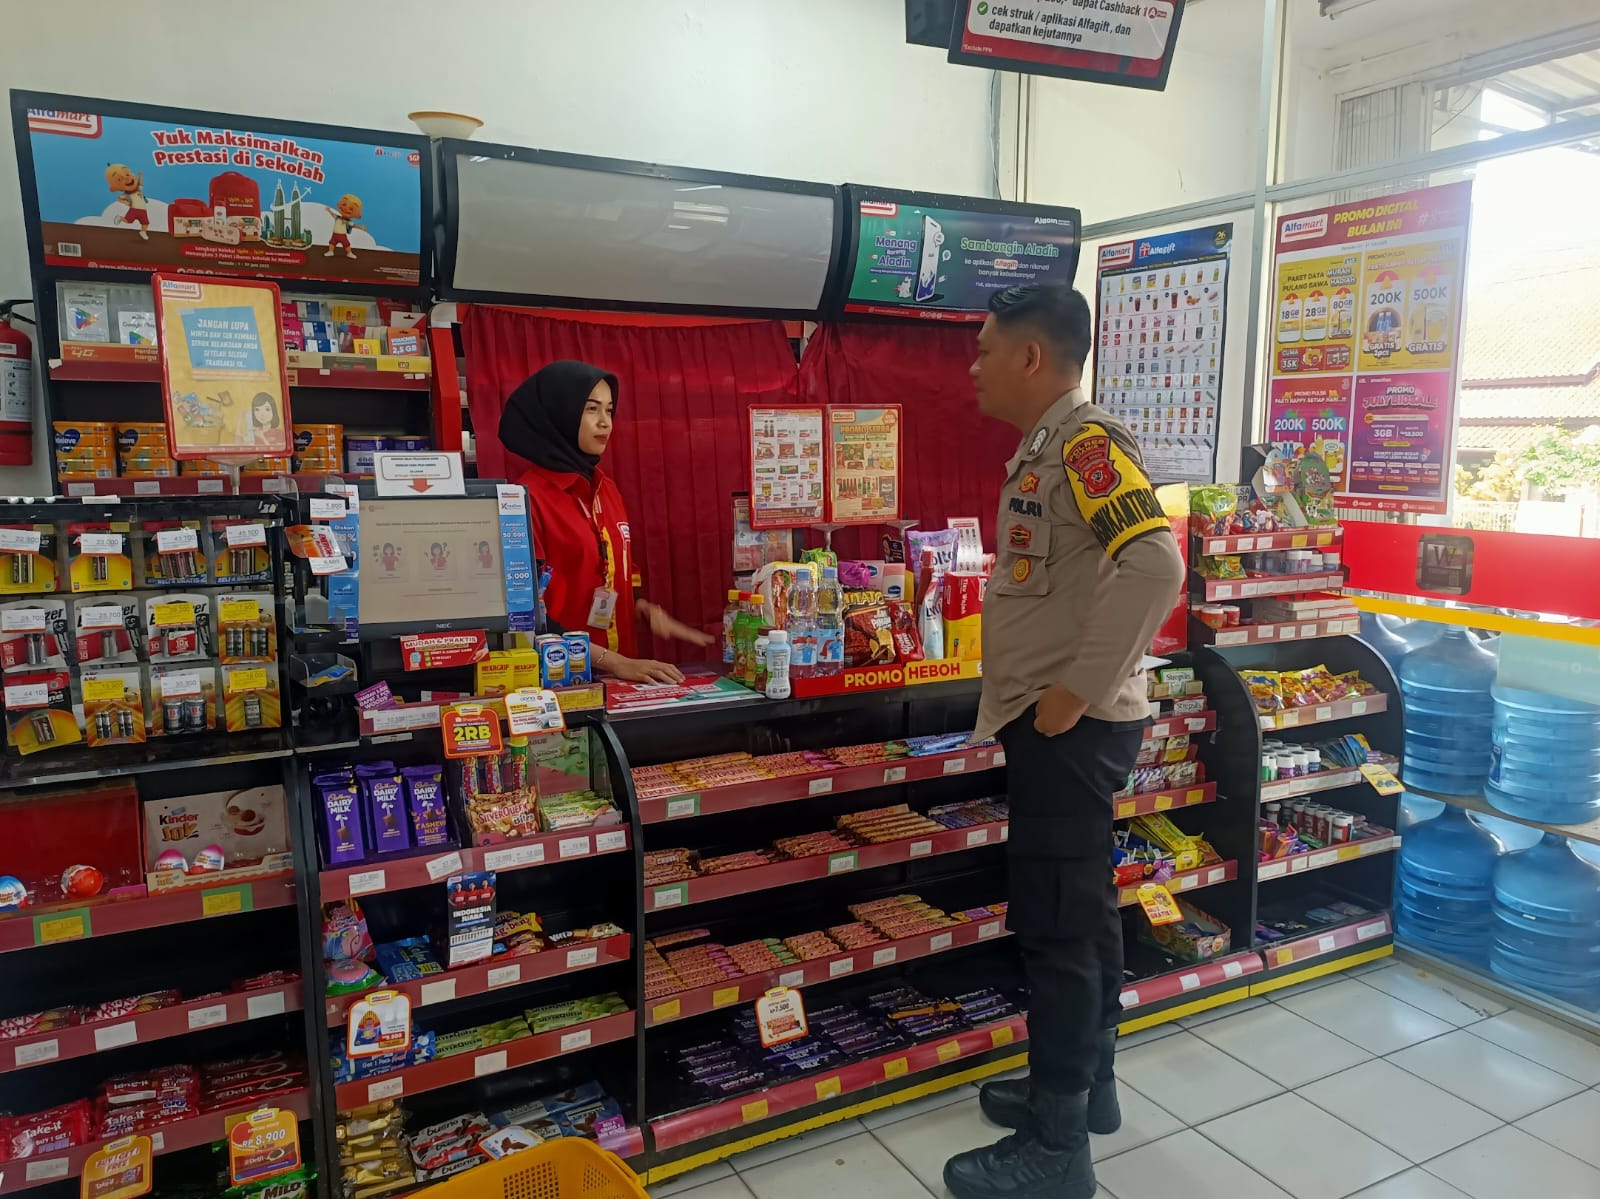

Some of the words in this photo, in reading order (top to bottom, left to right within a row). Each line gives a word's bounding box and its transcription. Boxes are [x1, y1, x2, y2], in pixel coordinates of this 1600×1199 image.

[1100, 0, 1141, 17] Cashback
[992, 6, 1008, 17] cek
[1009, 8, 1035, 21] struk
[1041, 13, 1076, 28] aplikasi
[1115, 25, 1132, 36] dan
[989, 18, 1031, 36] dapatkan
[1032, 26, 1082, 43] kejutannya
[153, 129, 191, 146] Yuk
[197, 131, 323, 165] Maksimalkan
[154, 149, 228, 166] Prestasi
[233, 150, 251, 165] di
[255, 155, 325, 183] Sekolah
[1333, 206, 1376, 225] PROMO
[1376, 200, 1419, 218] DIGITAL
[1284, 219, 1323, 233] Alfamart
[1347, 222, 1385, 238] BULAN
[1386, 220, 1404, 234] INI
[875, 236, 917, 250] Menang
[961, 238, 1023, 256] Sambungin
[1024, 241, 1060, 258] Aladin
[1101, 246, 1132, 258] Alfamart
[878, 256, 912, 267] Aladin
[1287, 274, 1307, 283] PAKET
[1308, 271, 1325, 280] DATA
[1326, 267, 1351, 277] MURAH
[162, 282, 196, 291] Alfamart
[1282, 283, 1308, 292] PULANG
[1308, 280, 1329, 289] BAWA
[1370, 290, 1403, 305] 200K
[1413, 286, 1448, 302] 500K
[197, 319, 229, 330] JANGAN
[230, 320, 249, 331] LUPA
[405, 344, 418, 353] GB
[1369, 342, 1394, 351] GRATIS
[1408, 342, 1445, 353] GRATIS
[1282, 360, 1299, 369] 35K
[1386, 386, 1415, 395] PROMO
[1274, 418, 1304, 431] 200K
[1311, 417, 1344, 431] 500K
[1373, 429, 1393, 438] 3GB
[1008, 497, 1042, 518] POLRI
[200, 574, 208, 583] 2
[260, 573, 268, 581] 2
[507, 572, 530, 580] 5.000
[175, 639, 189, 647] 10x
[405, 639, 436, 649] MUDAH
[443, 636, 477, 644] PRAKTIS
[6, 657, 16, 665] 10
[80, 651, 89, 659] 10
[844, 669, 904, 688] PROMO
[908, 662, 961, 680] HEBOH
[454, 725, 492, 741] 2RB
[373, 787, 399, 797] DAIRY
[413, 786, 438, 796] DAIRY
[416, 793, 436, 801] MILK
[327, 798, 353, 809] DAIRY
[376, 795, 397, 803] MILK
[330, 806, 351, 815] MILK
[159, 813, 199, 826] Kinder
[416, 821, 447, 831] CASHEW
[425, 827, 439, 835] NUT
[452, 905, 492, 918] INDONESIA
[461, 912, 484, 923] JUARA
[222, 1071, 249, 1083] Delfi
[225, 1085, 254, 1098] Delfi
[105, 1109, 145, 1126] Take-it
[24, 1120, 63, 1139] Take-it
[427, 1119, 459, 1137] bueno
[35, 1137, 50, 1146] BUY
[54, 1133, 68, 1142] GET
[255, 1129, 287, 1145] 8.900
[441, 1157, 476, 1174] bueno
[264, 1181, 305, 1199] MILO
